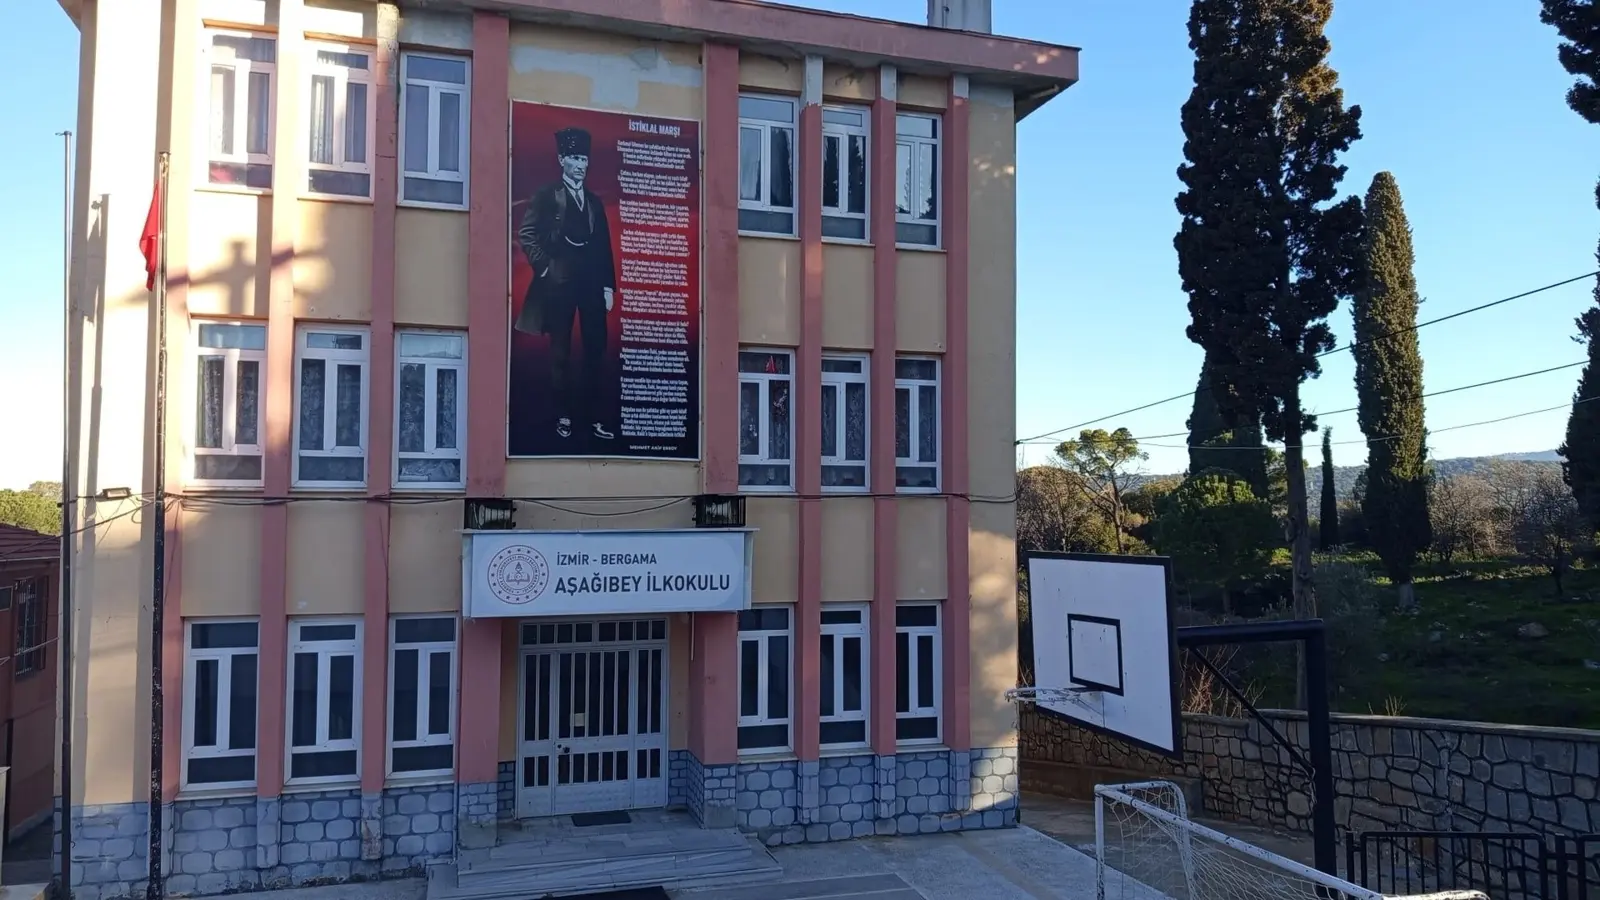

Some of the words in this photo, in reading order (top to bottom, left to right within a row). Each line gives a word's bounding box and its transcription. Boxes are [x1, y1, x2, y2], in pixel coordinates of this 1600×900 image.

[629, 119, 658, 133] İSTİKLAL
[659, 125, 681, 138] MARŞI
[557, 552, 589, 565] İZMİR
[601, 553, 657, 565] BERGAMA
[554, 572, 642, 596] AŞAĞIBEY
[647, 571, 730, 592] İLKOKULU
